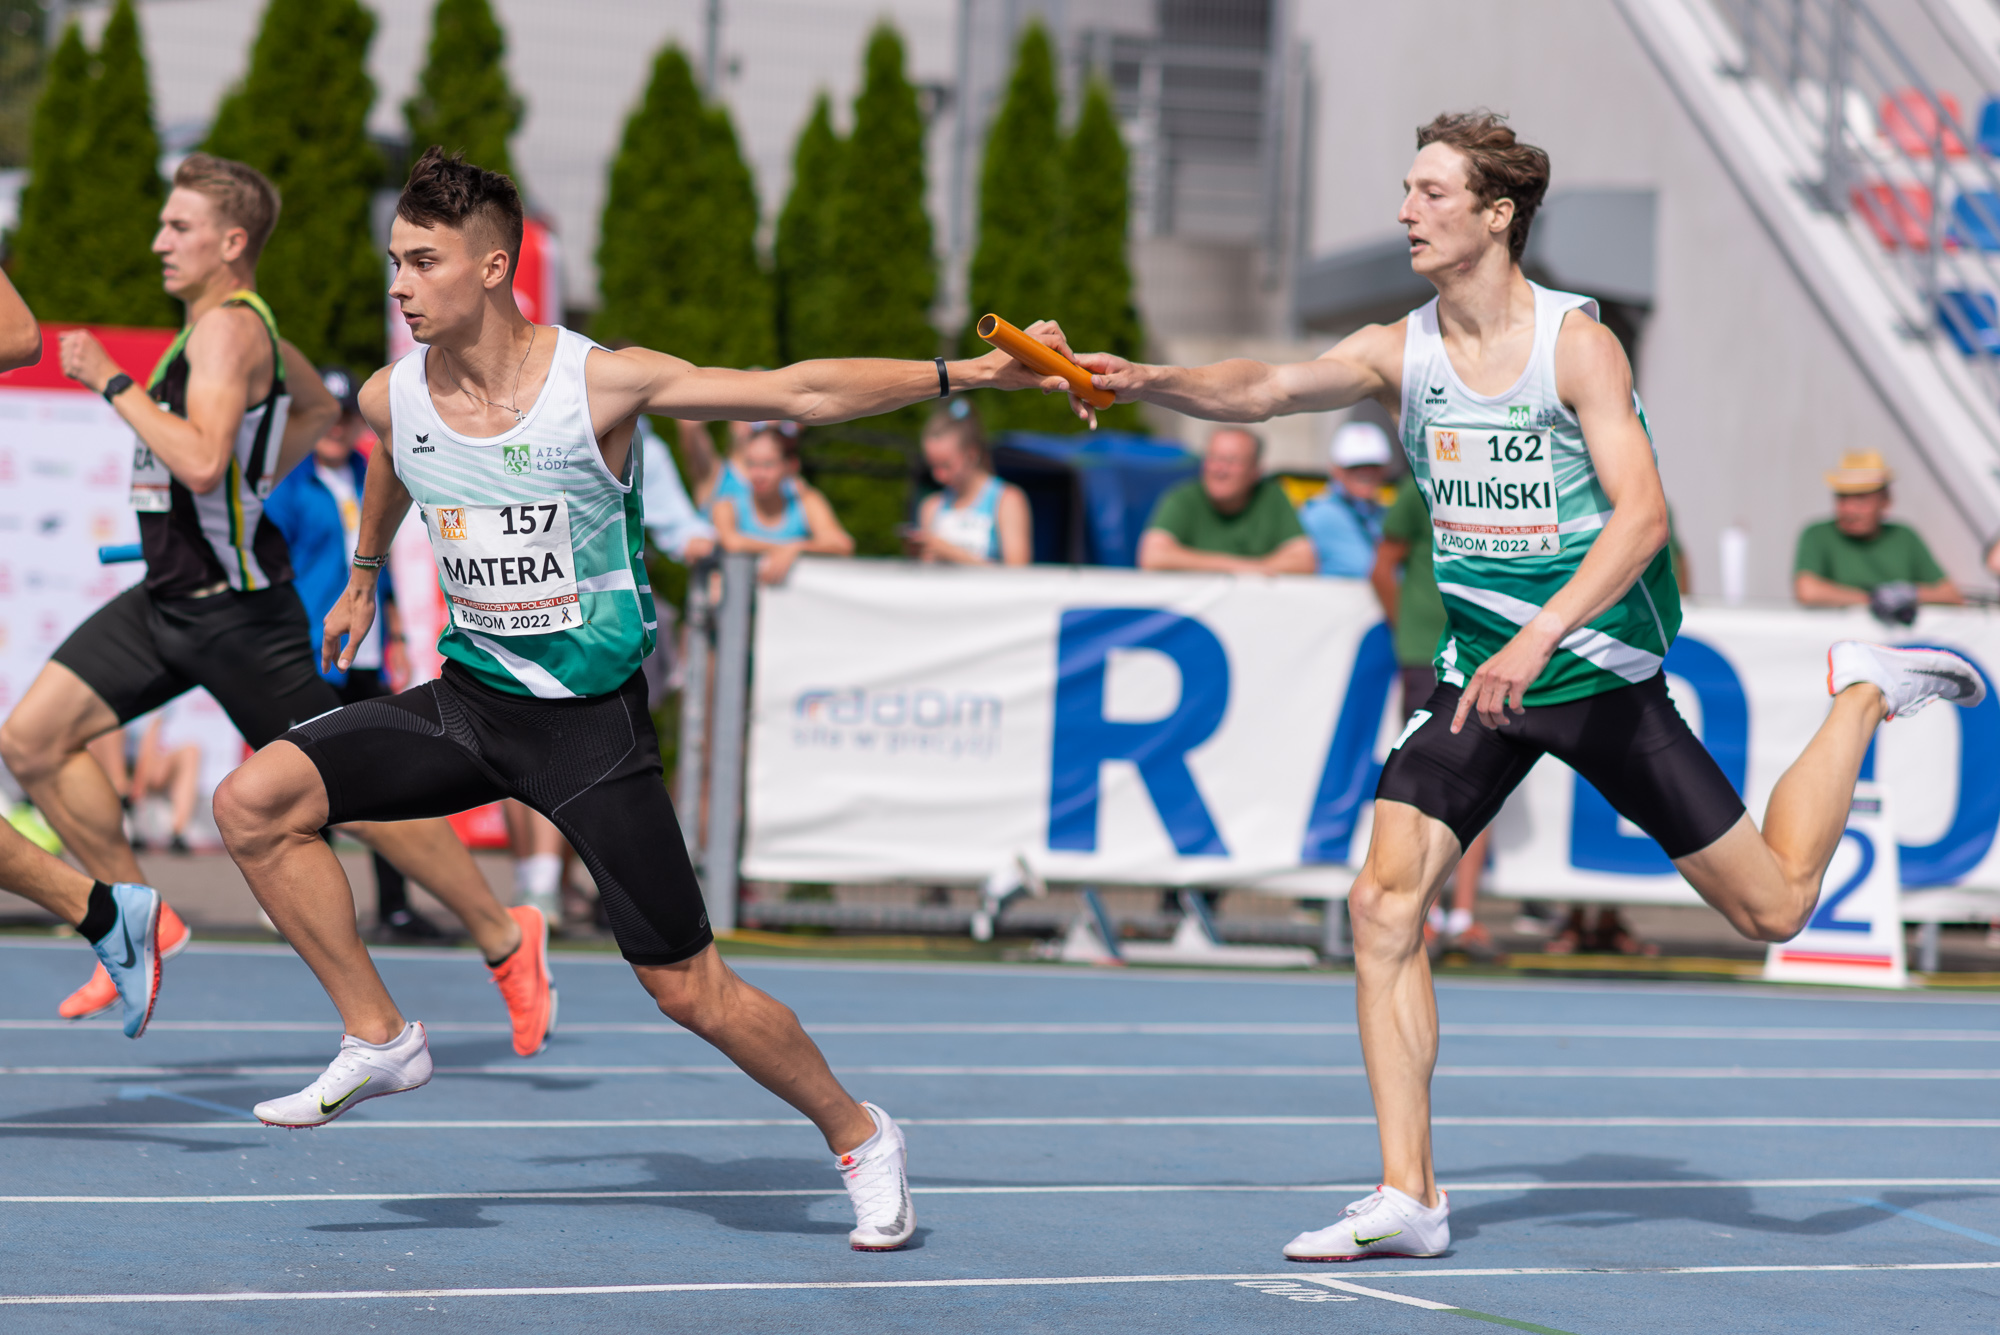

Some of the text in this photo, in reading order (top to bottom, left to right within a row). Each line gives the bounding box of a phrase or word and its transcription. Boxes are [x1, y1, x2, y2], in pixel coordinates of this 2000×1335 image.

[412, 445, 435, 454] erima
[536, 447, 562, 458] AZS
[1488, 434, 1544, 463] 162
[1431, 476, 1552, 510] WILIŃSKI
[499, 503, 558, 535] 157
[1503, 526, 1535, 534] POLSKI
[1536, 525, 1556, 533] U20
[1441, 533, 1530, 552] RADOM 2022
[442, 552, 565, 587] MATERA
[521, 599, 555, 610] POLSKI
[556, 596, 576, 605] U20
[461, 609, 551, 630] RADOM 2022
[1807, 828, 1876, 931] 2
